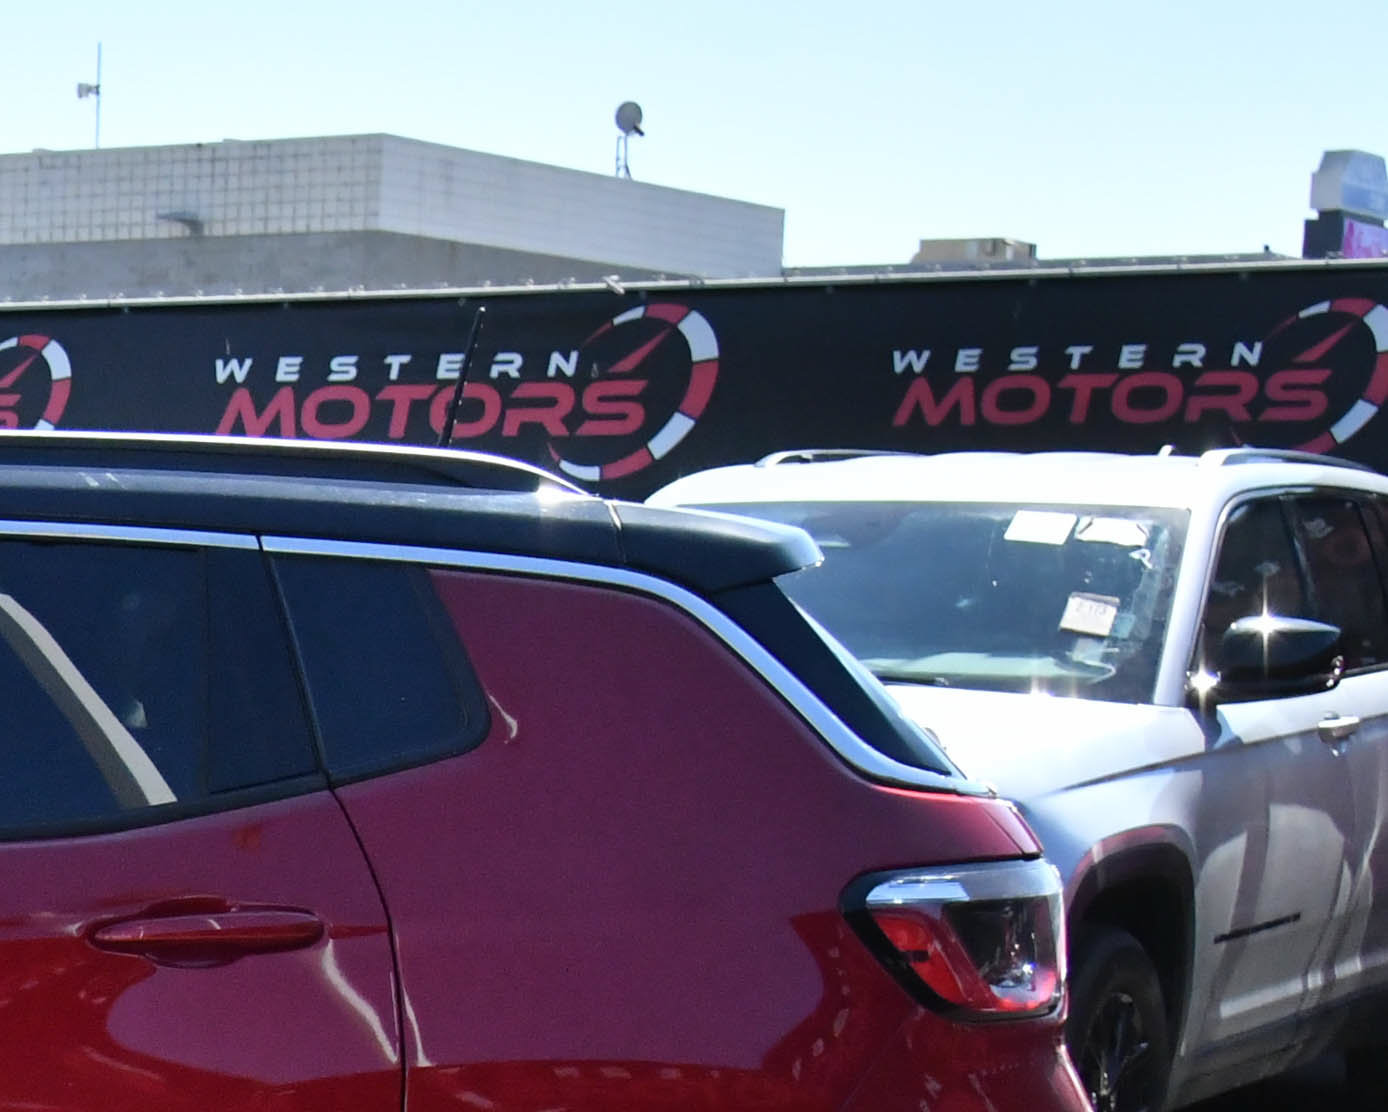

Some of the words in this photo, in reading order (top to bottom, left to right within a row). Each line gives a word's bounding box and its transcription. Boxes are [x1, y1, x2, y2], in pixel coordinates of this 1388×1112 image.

[215, 349, 581, 385] WESTERN
[892, 341, 1264, 374] WESTERN
[214, 379, 648, 440] MOTORS
[891, 367, 1333, 427] MOTORS
